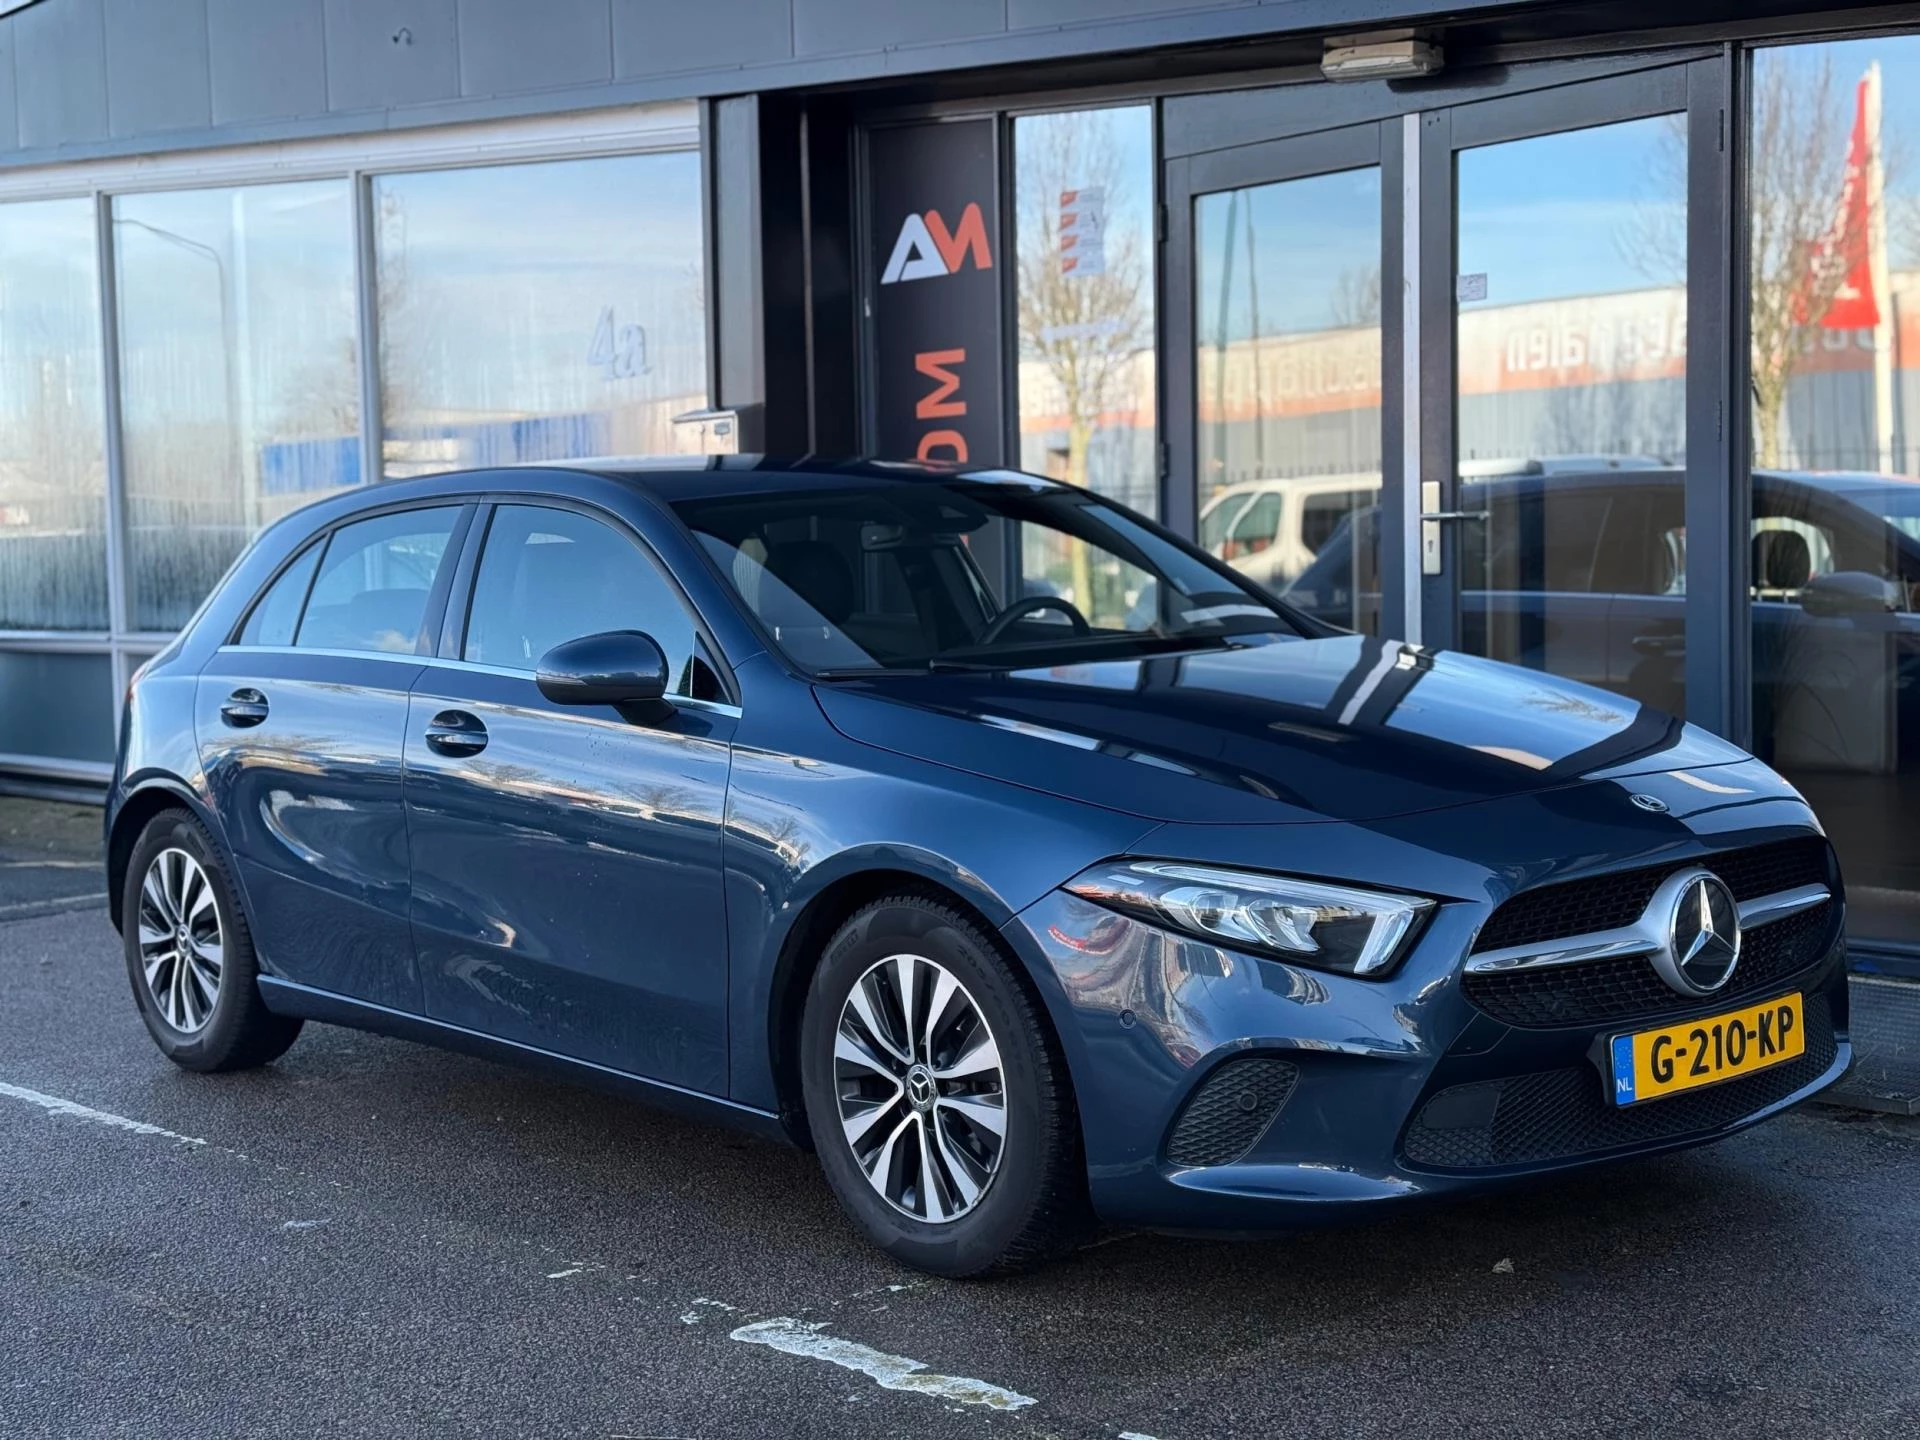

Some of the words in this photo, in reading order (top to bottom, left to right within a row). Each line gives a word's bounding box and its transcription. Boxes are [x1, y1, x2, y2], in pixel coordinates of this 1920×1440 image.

[881, 202, 992, 284] AM
[587, 305, 651, 381] 4a
[1651, 1005, 1794, 1084] G-210-KP
[1617, 1079, 1633, 1093] NL
